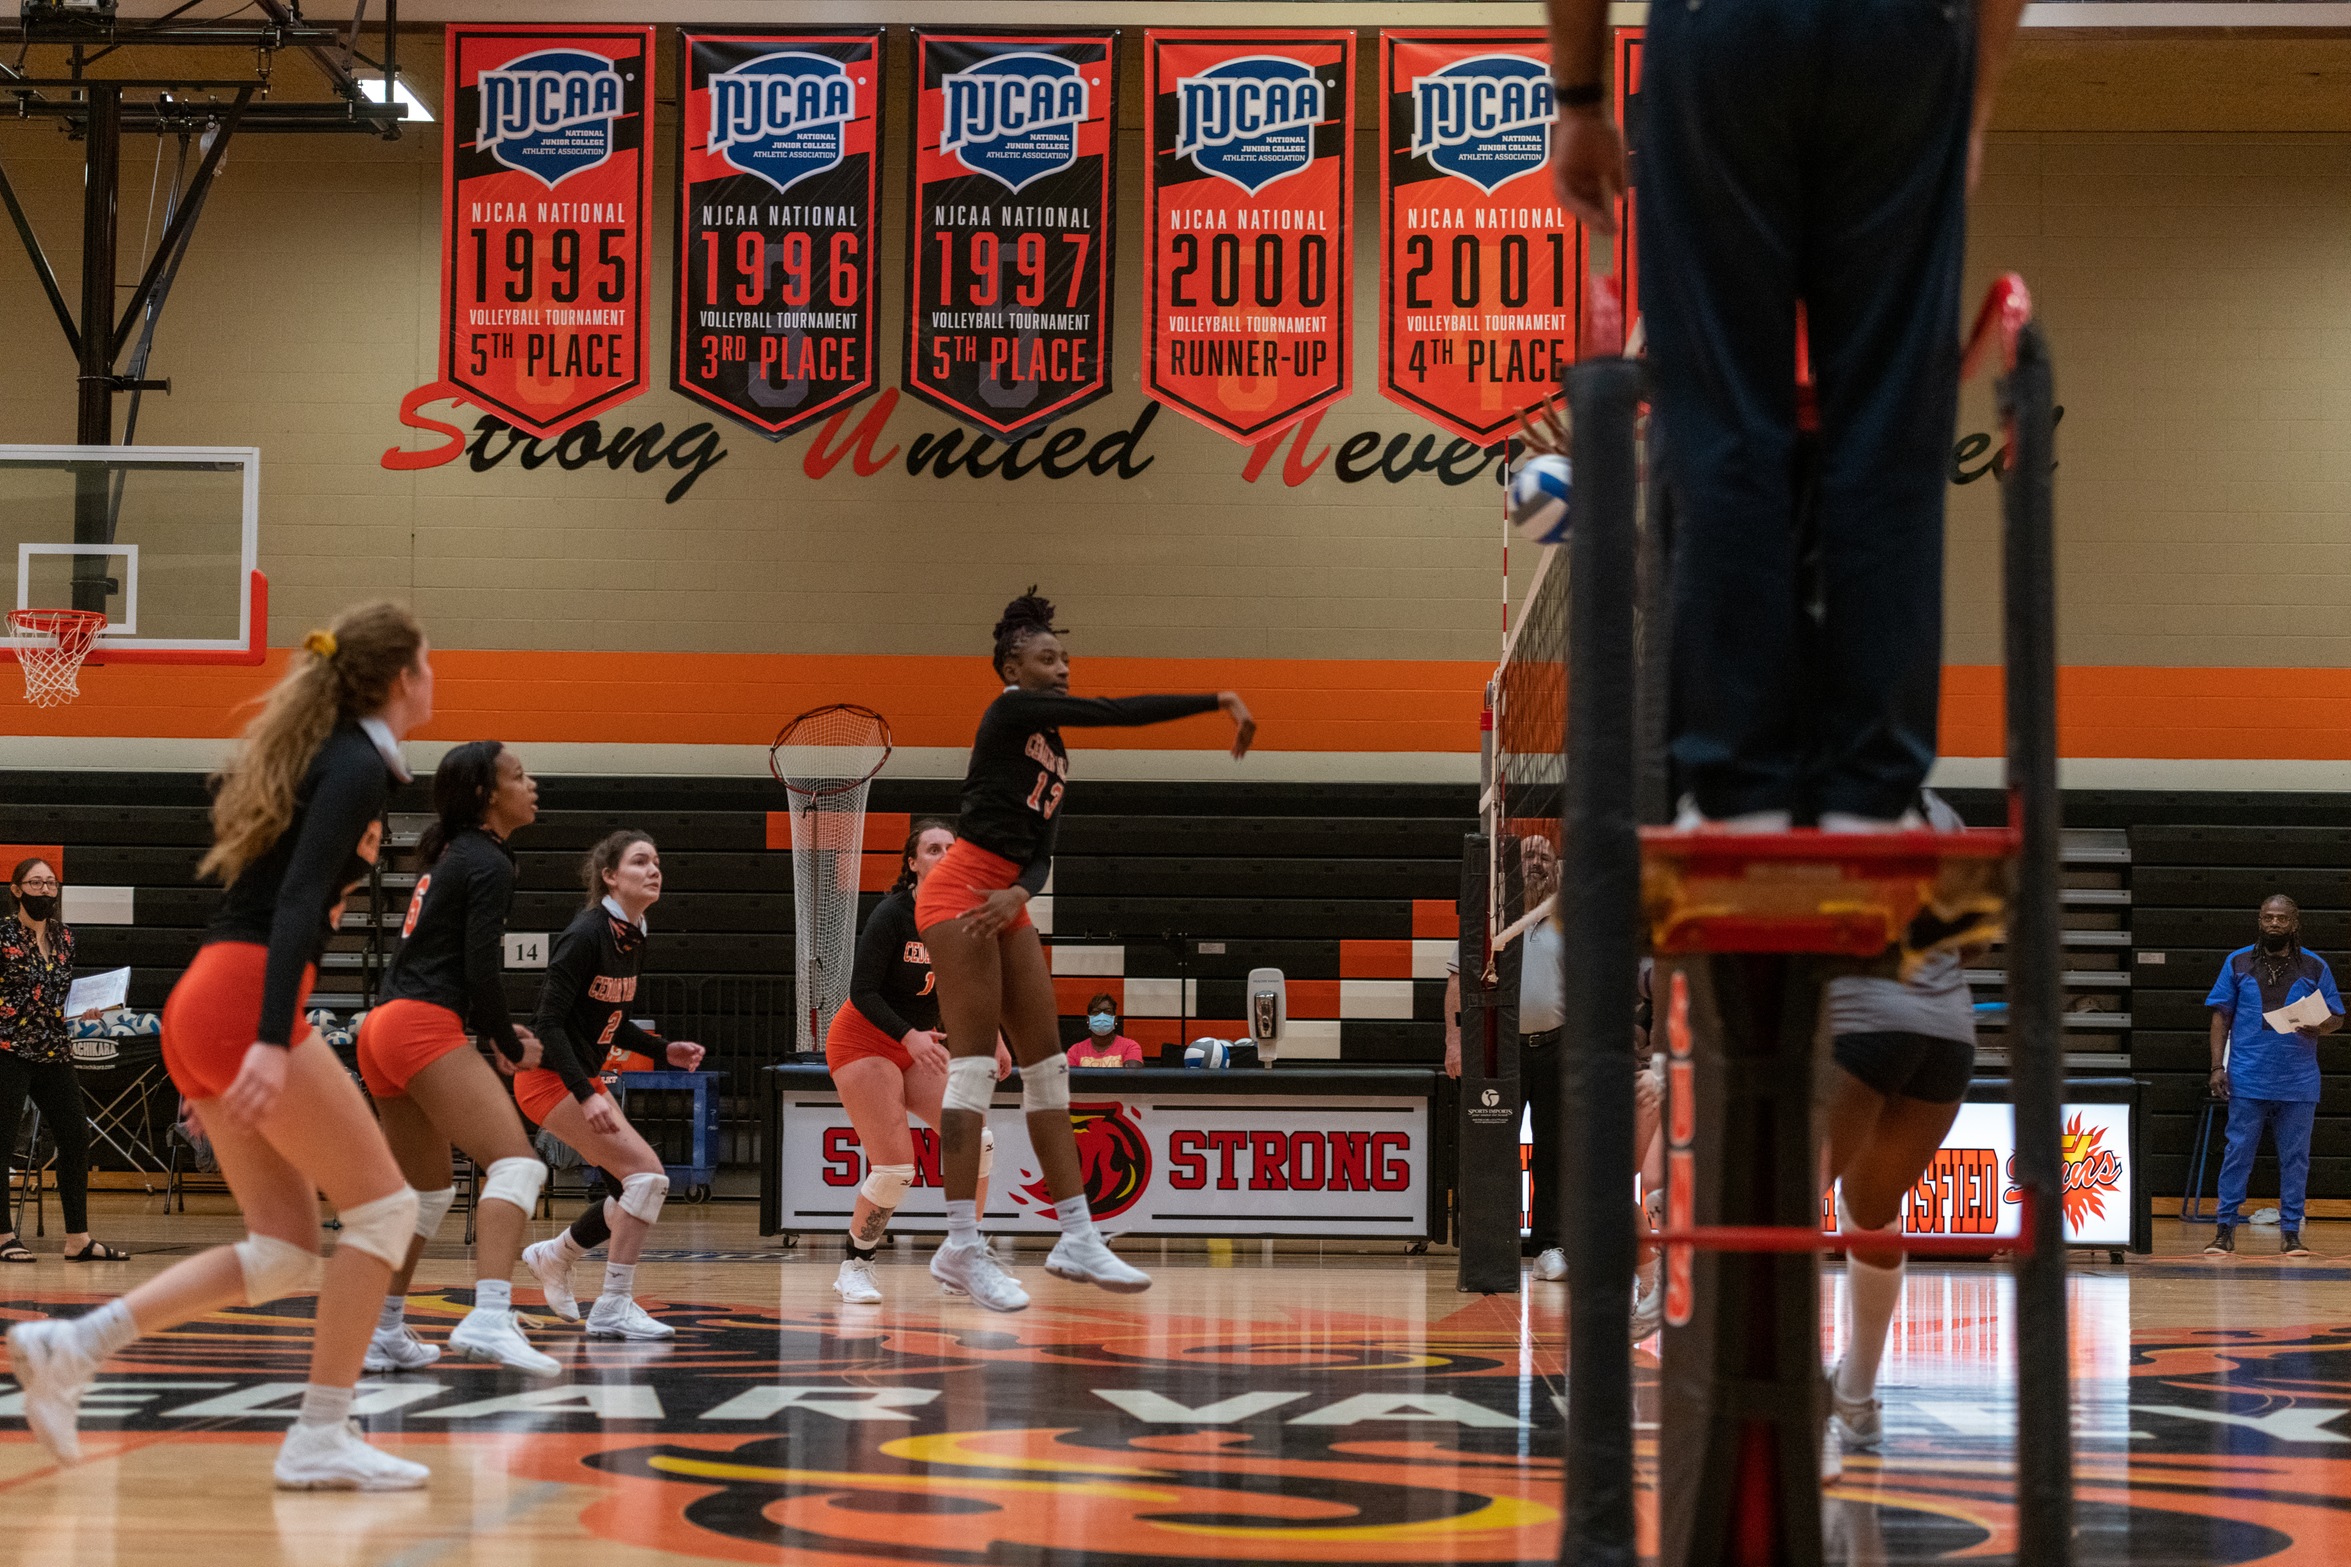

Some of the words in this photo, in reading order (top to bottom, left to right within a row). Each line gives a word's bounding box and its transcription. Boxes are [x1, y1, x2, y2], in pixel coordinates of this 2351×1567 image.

[480, 71, 622, 146] NJCAA
[711, 74, 855, 149] NJCAA
[943, 74, 1087, 149] NJCAA
[1178, 78, 1324, 153] NJCAA
[1414, 77, 1560, 152] NJCAA
[797, 133, 836, 141] NATIONAL
[1005, 142, 1034, 150] JUNIOR
[1035, 142, 1069, 150] COLLEGE
[1266, 136, 1305, 144] NATIONAL
[522, 147, 556, 155] ATHLETIC
[558, 147, 604, 155] ASSOCIATION
[753, 150, 787, 158] ATHLETIC
[789, 150, 836, 159] ASSOCIATION
[986, 151, 1020, 159] ATHLETIC
[1022, 151, 1069, 160] ASSOCIATION
[1222, 154, 1257, 162] ATHLETIC
[1258, 154, 1306, 162] ASSOCIATION
[1241, 145, 1270, 153] JUNIOR
[1272, 145, 1306, 153] COLLEGE
[1458, 153, 1493, 161] ATHLETIC
[1495, 153, 1542, 161] ASSOCIATION
[471, 202, 527, 223] NJCAA
[538, 203, 625, 223] NATIONAL
[703, 205, 758, 226] NJCAA
[769, 206, 857, 227] NATIONAL
[935, 205, 991, 226] NJCAA
[1002, 206, 1090, 228] NATIONAL
[1171, 209, 1227, 230] NJCAA
[1237, 210, 1327, 231] NATIONAL
[1408, 208, 1464, 229] NJCAA
[1475, 207, 1565, 229] NATIONAL
[471, 228, 626, 304] 1995
[701, 231, 859, 307] 1996
[935, 231, 1090, 308] 1997
[1171, 233, 1327, 308] 2000
[1407, 233, 1564, 309] 2001
[470, 309, 541, 326] VOLLEYBALL
[545, 309, 625, 327] TOURNAMENT
[700, 311, 772, 329] VOLLEYBALL
[777, 312, 858, 330] TOURNAMENT
[932, 311, 1003, 330] VOLLEYBALL
[1008, 313, 1090, 331] TOURNAMENT
[1169, 315, 1241, 333] VOLLEYBALL
[1246, 316, 1327, 334] TOURNAMENT
[1407, 315, 1480, 332] VOLLEYBALL
[1484, 314, 1566, 332] TOURNAMENT
[471, 333, 513, 377] 5TH
[527, 334, 622, 378] PLACE
[701, 335, 746, 380] 3RD
[760, 336, 856, 381] PLACE
[933, 335, 977, 380] 5TH
[991, 337, 1087, 382] PLACE
[1171, 339, 1327, 378] RUNNER-UP
[1408, 339, 1454, 383] 4TH
[1468, 339, 1565, 383] PLACE
[516, 943, 538, 961] 14
[597, 1010, 623, 1045] 2
[71, 1042, 117, 1057] ACHIKARA
[1169, 1130, 1410, 1192] STRONG
